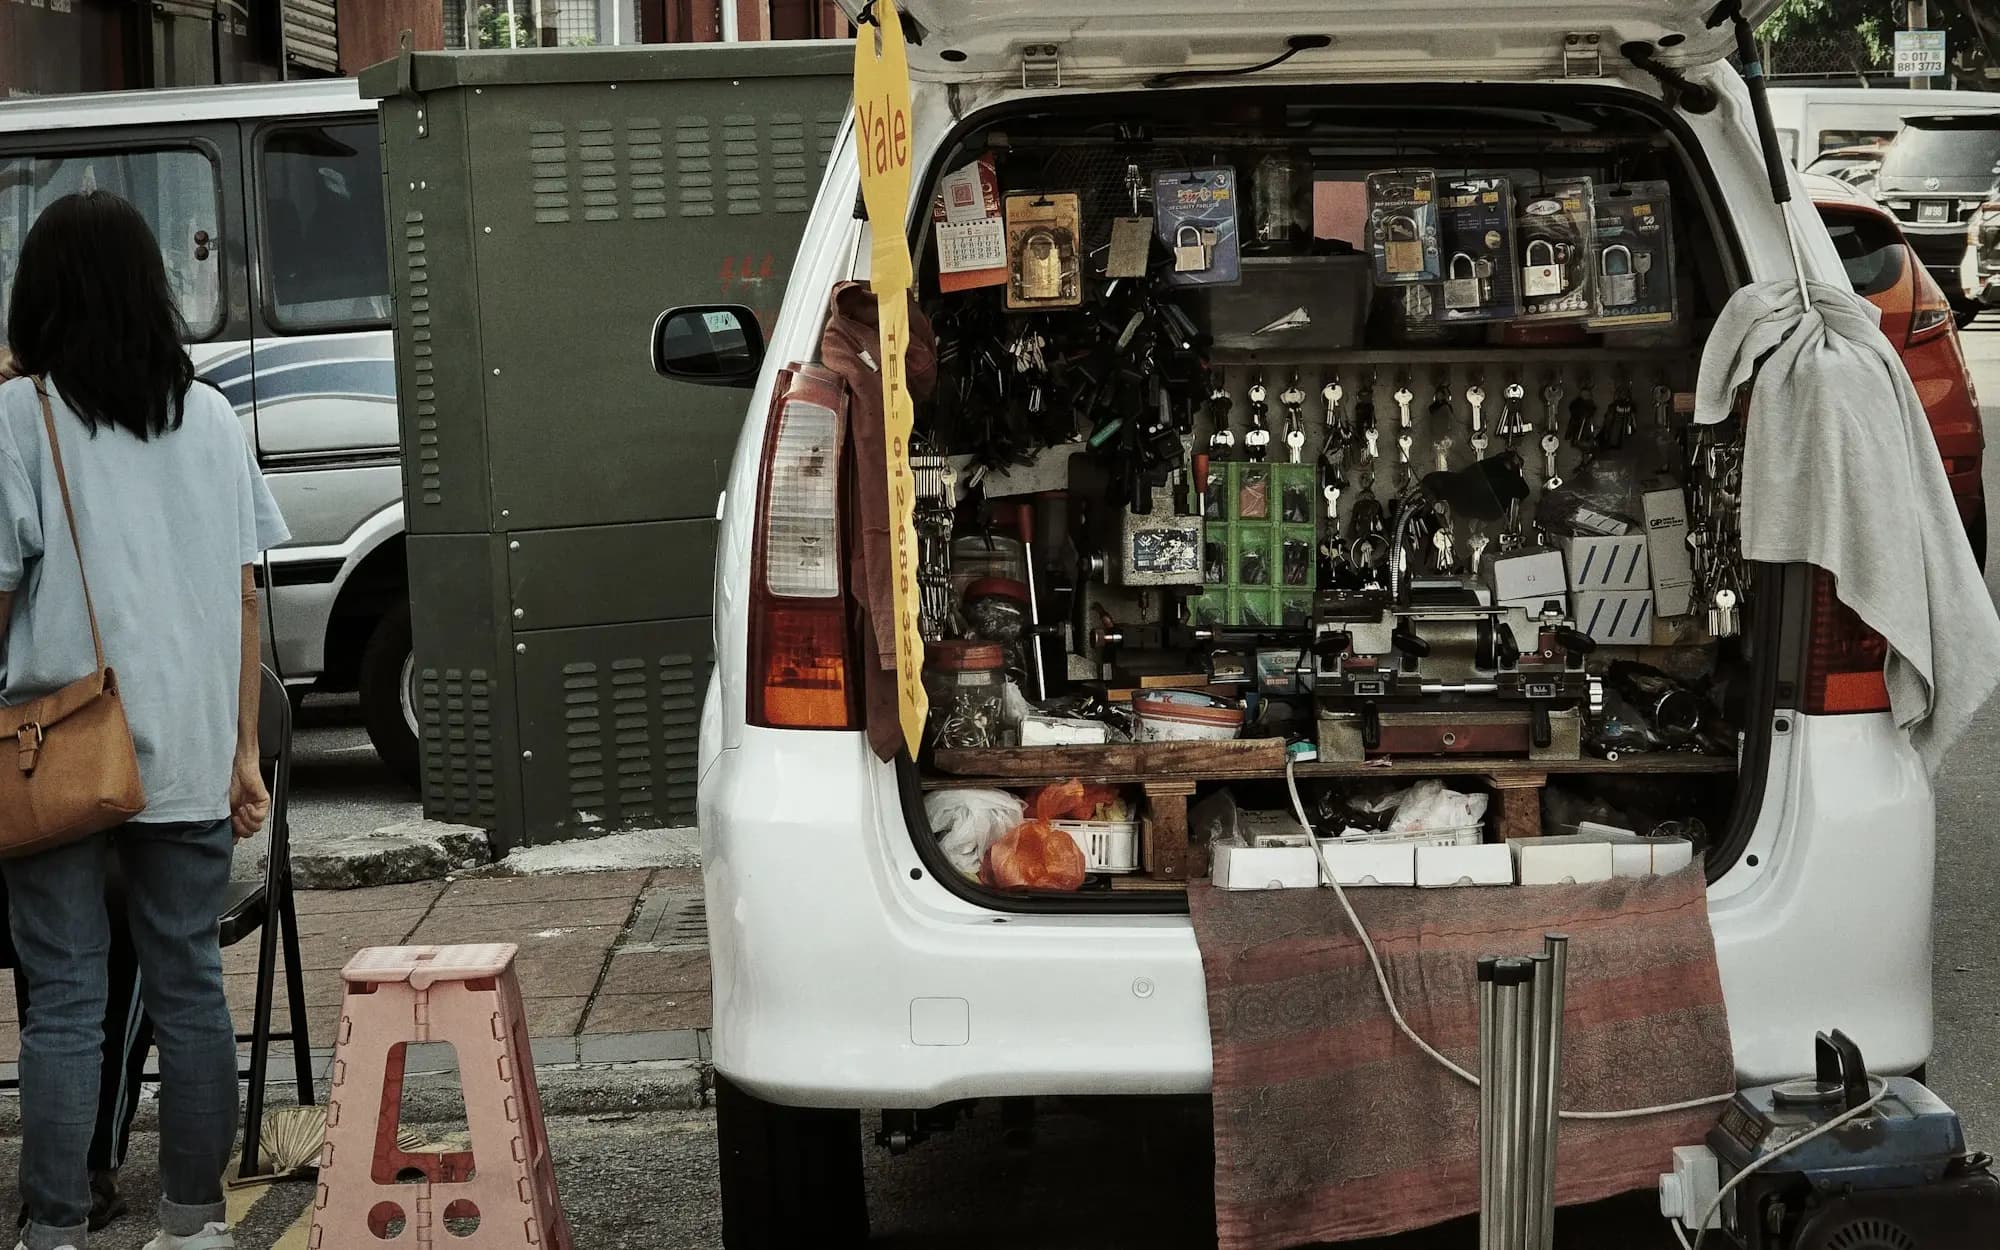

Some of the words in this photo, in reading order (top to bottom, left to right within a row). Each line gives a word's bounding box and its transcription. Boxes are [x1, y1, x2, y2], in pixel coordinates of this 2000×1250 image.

[1911, 52, 1928, 61] 017
[1918, 61, 1942, 71] 3773
[859, 93, 906, 178] Yale
[887, 320, 899, 420] TEL:
[902, 610, 915, 707] 3237
